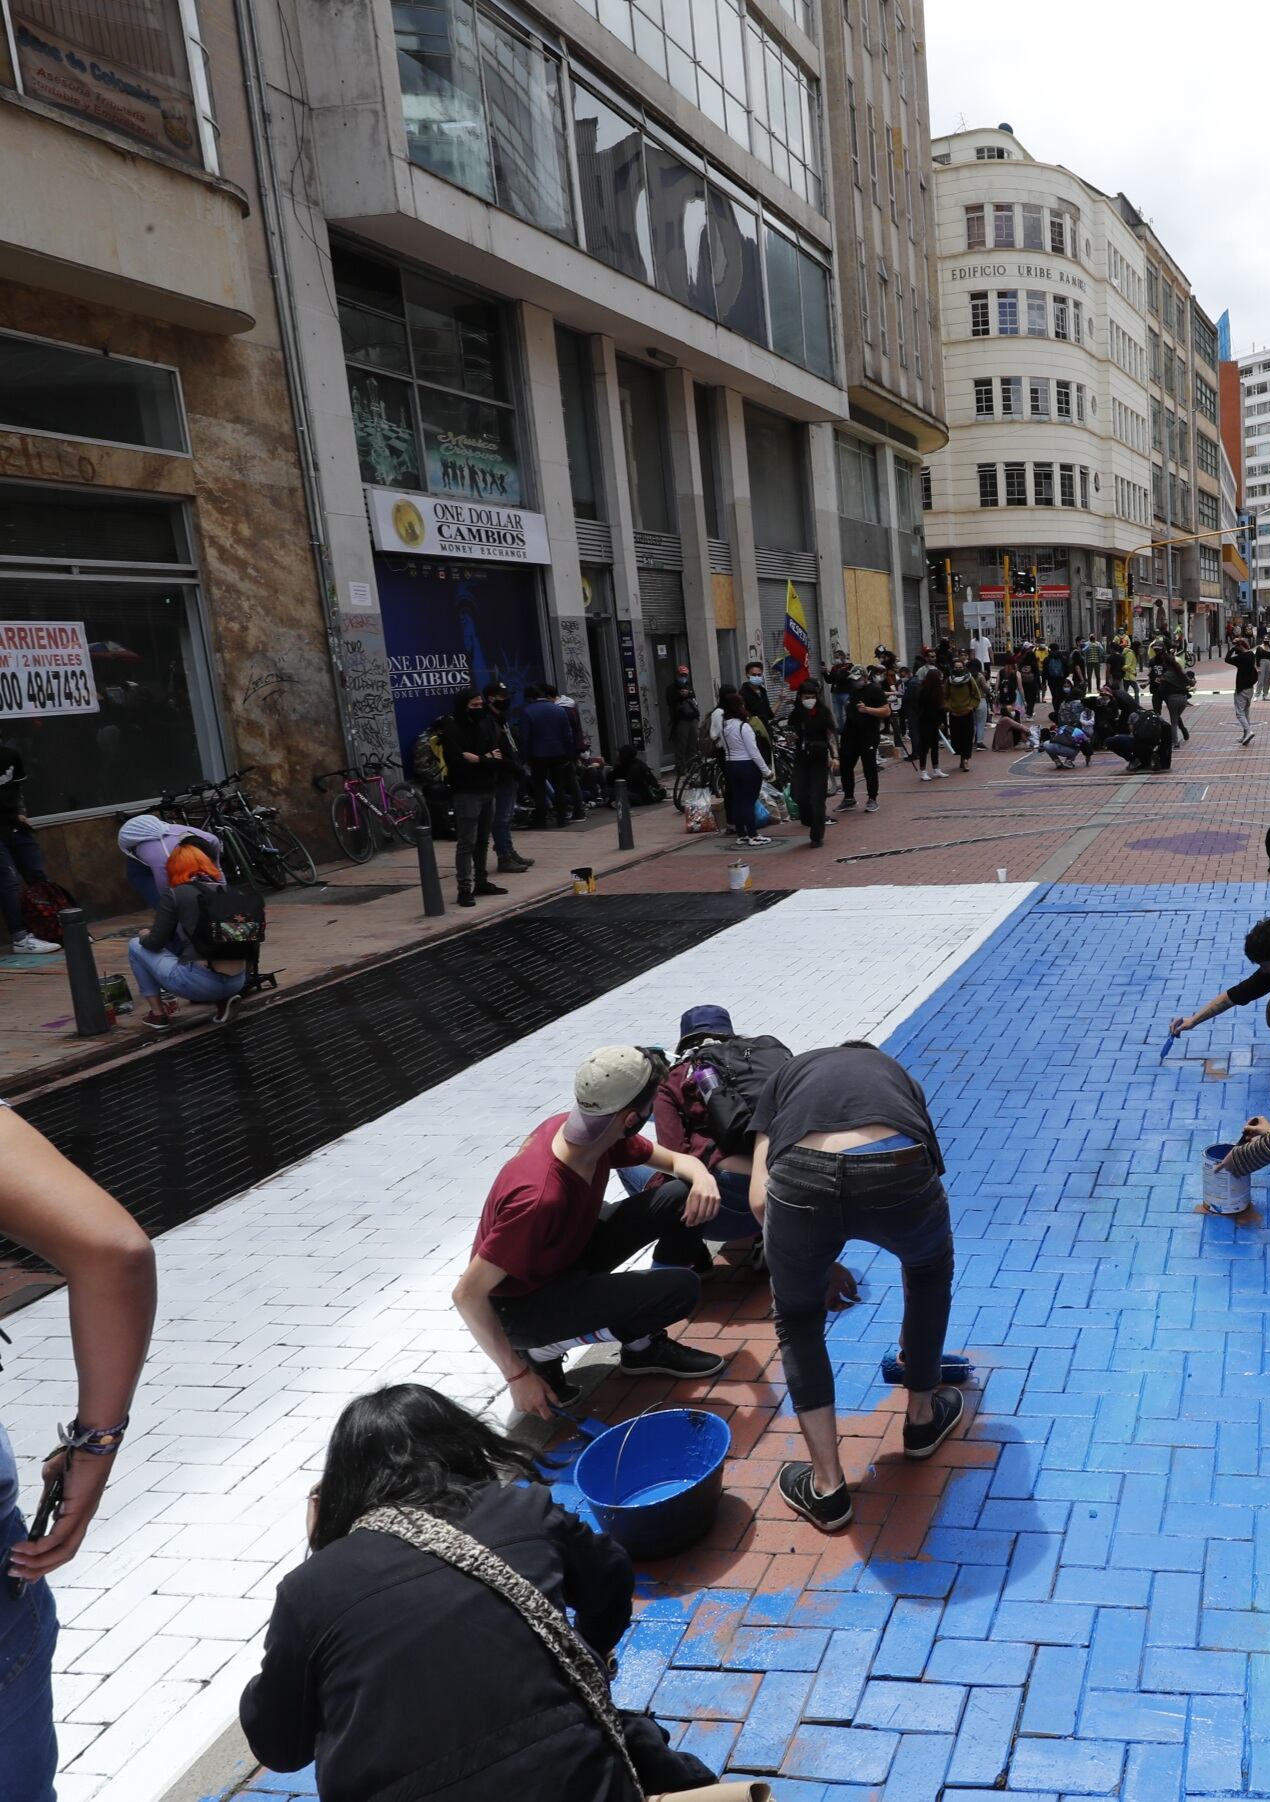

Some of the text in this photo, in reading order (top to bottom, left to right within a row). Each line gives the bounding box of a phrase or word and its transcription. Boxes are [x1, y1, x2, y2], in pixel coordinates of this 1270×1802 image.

[951, 265, 1006, 280] EDIFICIO
[1017, 265, 1052, 279] URIBE
[434, 503, 524, 530] ONE DOLLAR
[437, 524, 526, 547] CAMBIOS
[440, 543, 527, 559] MONEY EXCHANGE
[0, 627, 81, 650] ARRIENDA
[22, 655, 30, 668] 2
[32, 654, 82, 667] NIVELES
[415, 653, 469, 670] DOLLAR
[0, 669, 91, 711] 00 4847433
[393, 690, 420, 699] ONEY
